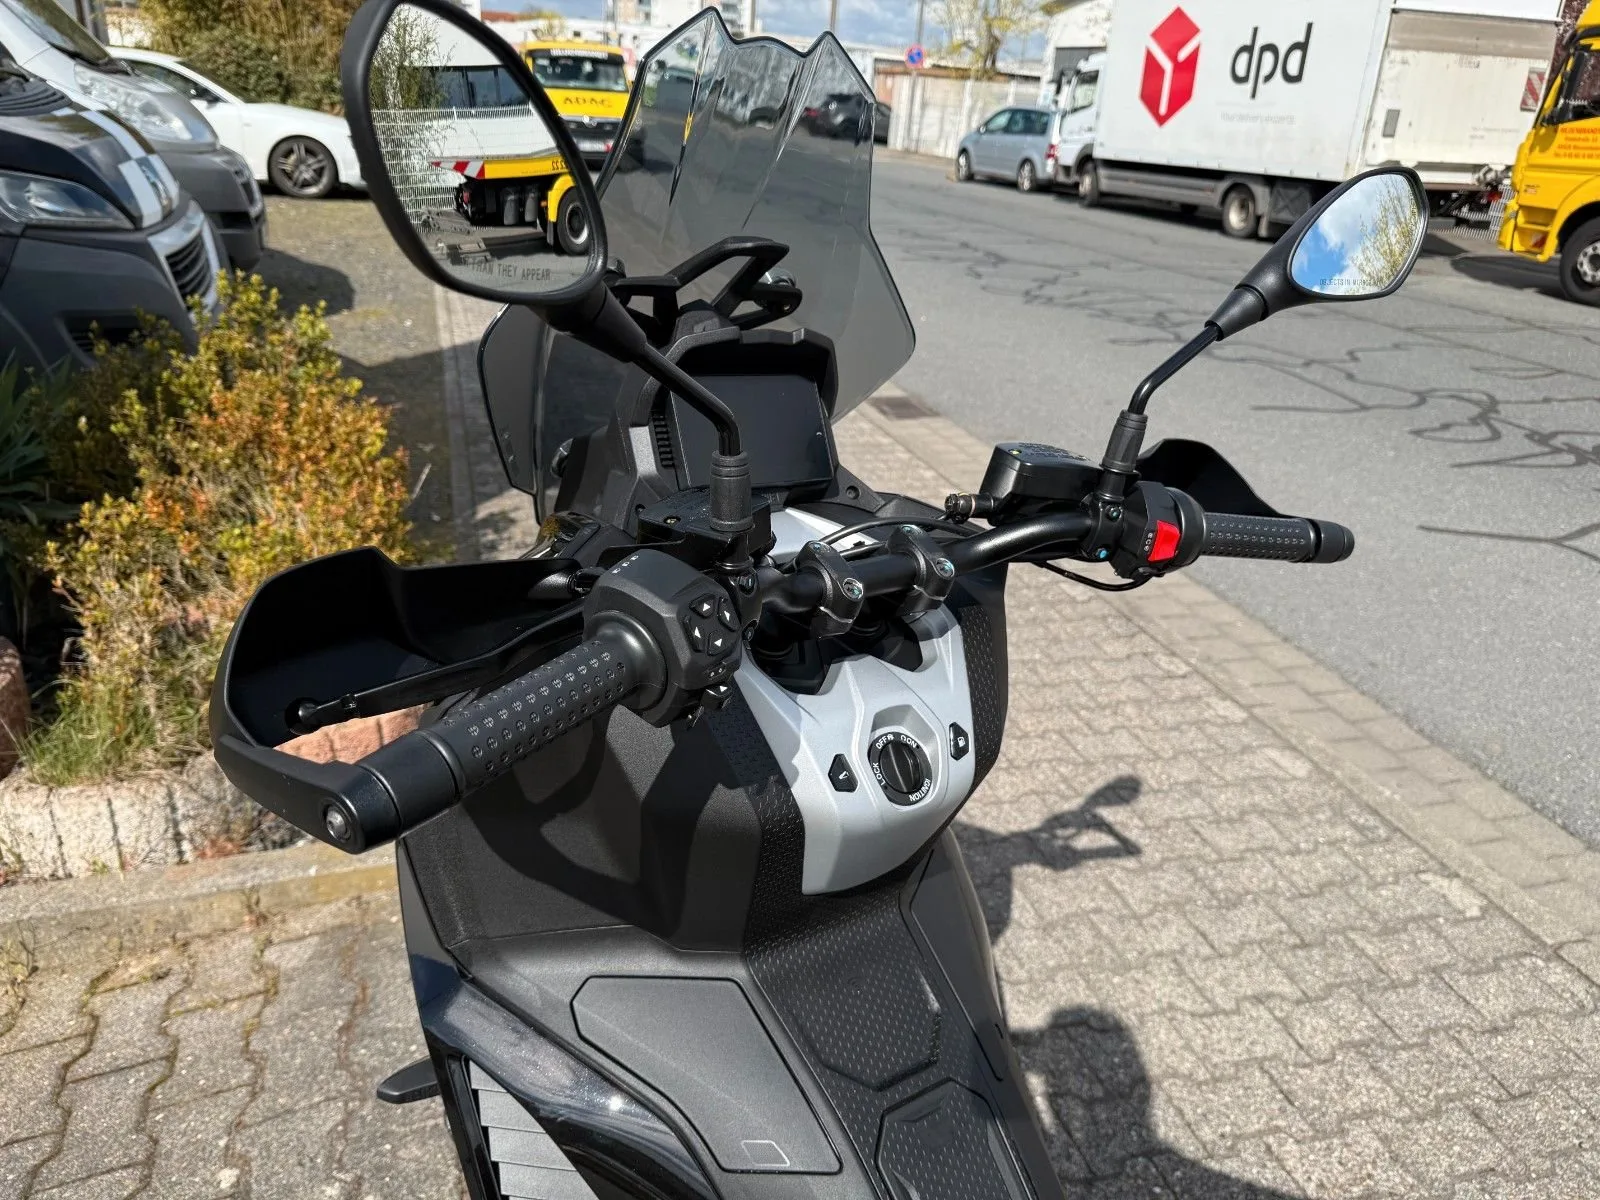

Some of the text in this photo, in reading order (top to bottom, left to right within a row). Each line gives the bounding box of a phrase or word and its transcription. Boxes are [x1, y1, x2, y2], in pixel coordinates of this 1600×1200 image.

[1230, 22, 1313, 99] dpd
[563, 96, 612, 108] ADAC
[498, 263, 518, 278] THEY
[521, 268, 551, 281] APPEAR
[875, 735, 888, 750] OFF
[873, 762, 886, 786] LOCK
[908, 778, 931, 802] IGNITION
